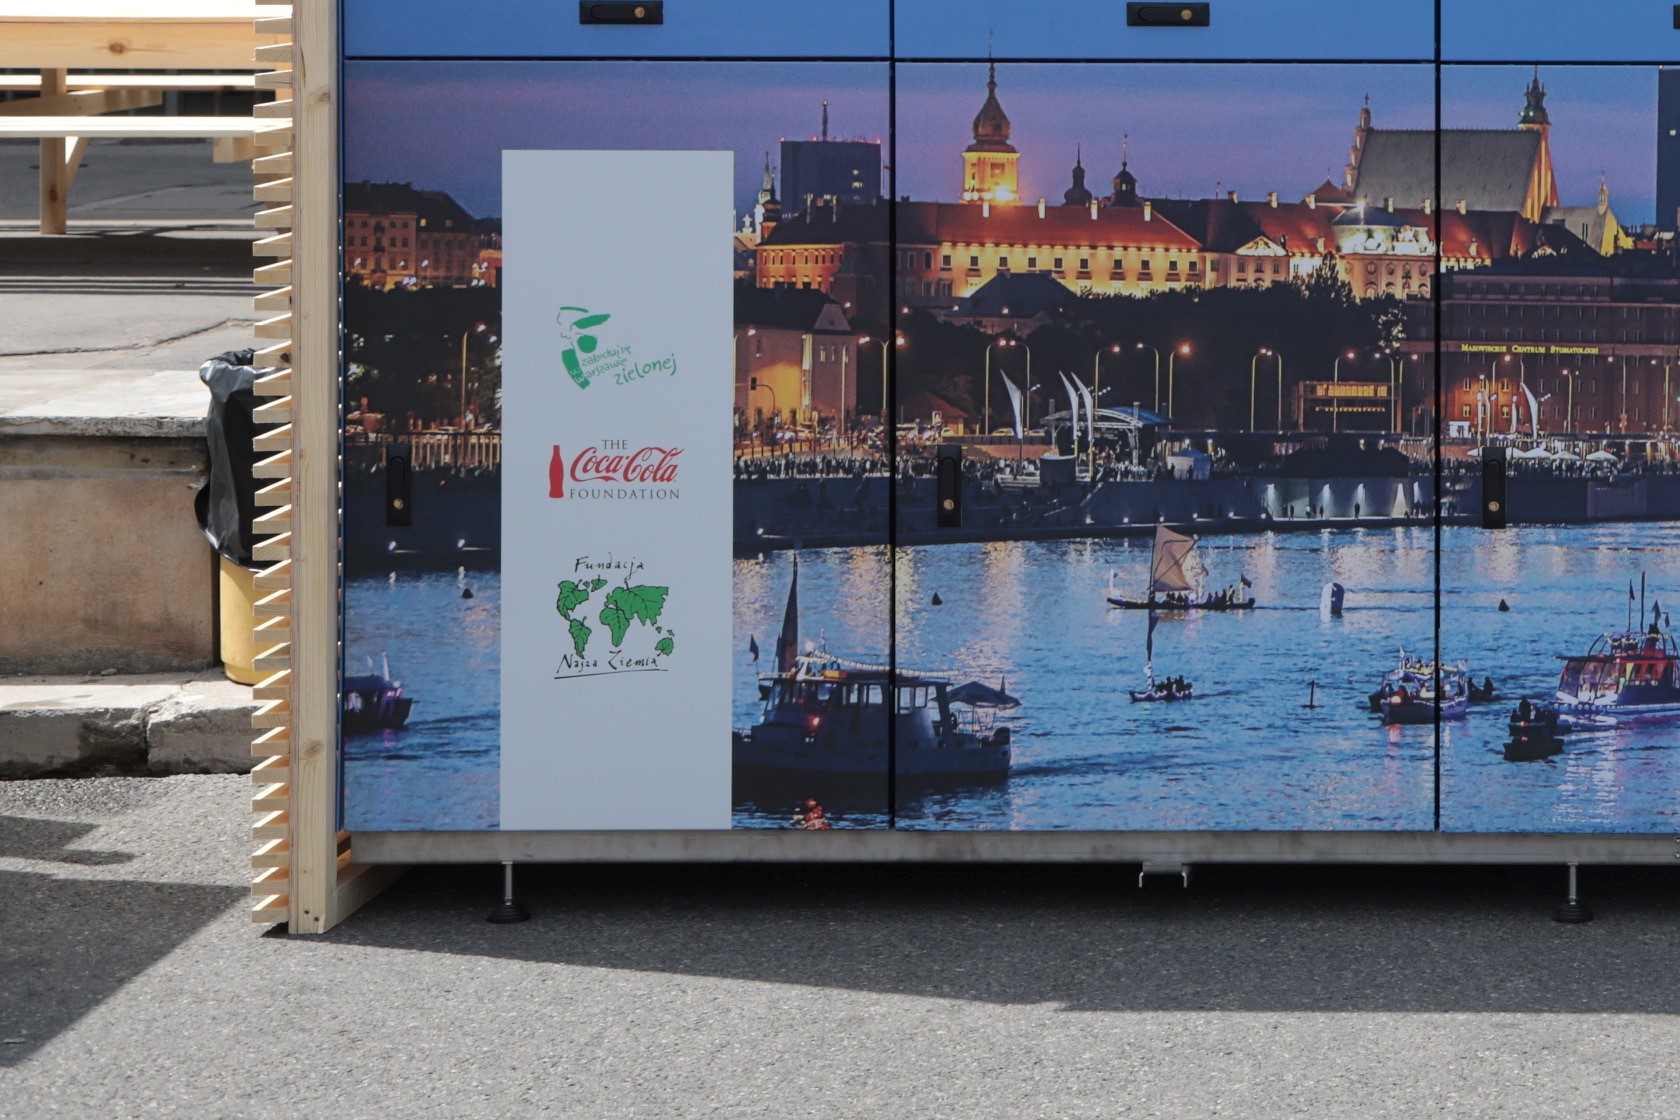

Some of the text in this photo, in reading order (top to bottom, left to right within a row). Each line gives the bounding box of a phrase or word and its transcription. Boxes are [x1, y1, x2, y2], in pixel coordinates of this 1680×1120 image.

[581, 345, 621, 367] zakochaj
[613, 352, 677, 385] zielonej
[601, 439, 628, 450] THE
[570, 446, 685, 483] Coca-Cola
[569, 488, 680, 500] FOUNDATION
[574, 551, 644, 580] Fundacja
[608, 649, 659, 670] Ziemia
